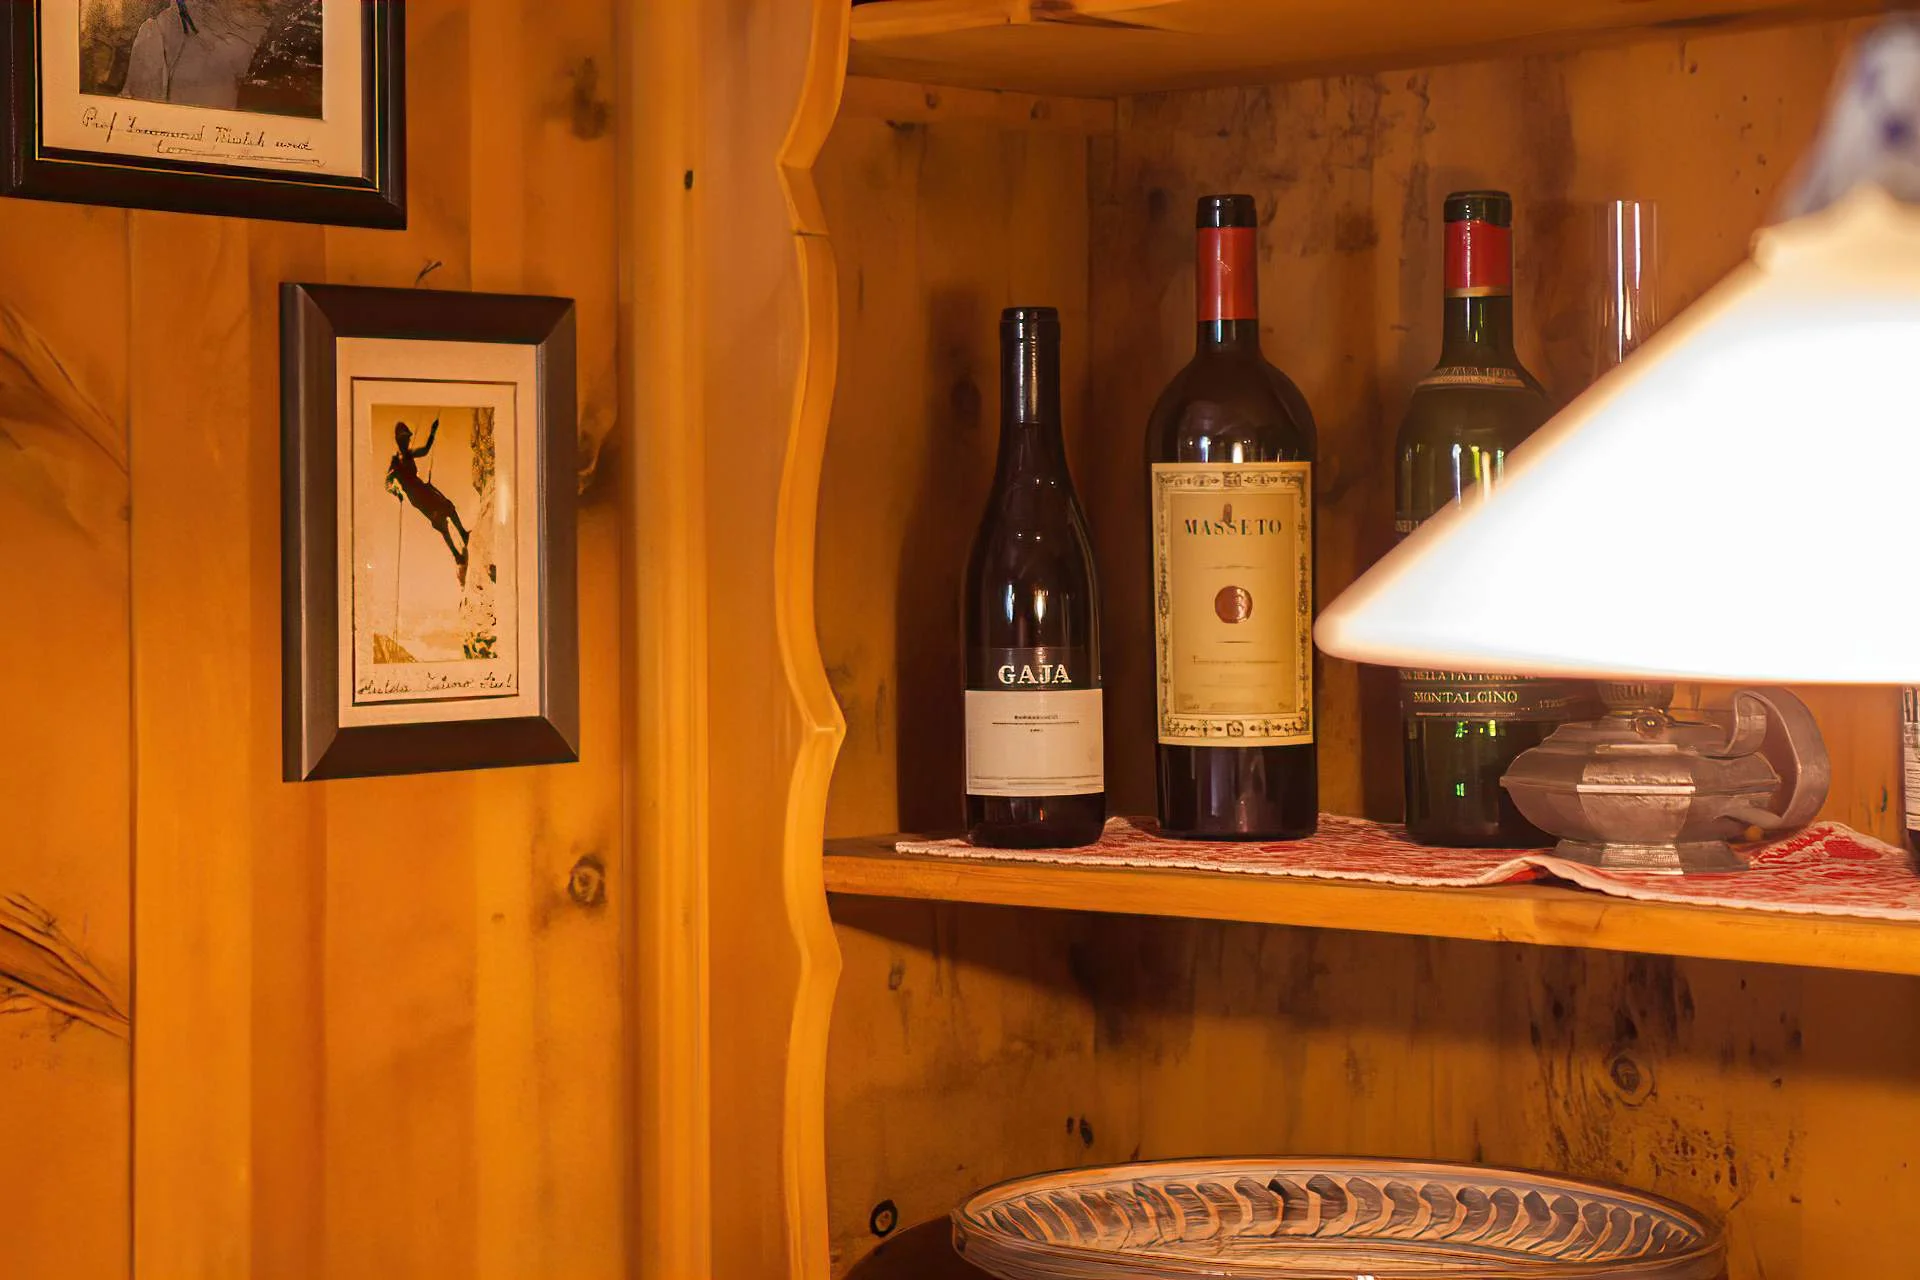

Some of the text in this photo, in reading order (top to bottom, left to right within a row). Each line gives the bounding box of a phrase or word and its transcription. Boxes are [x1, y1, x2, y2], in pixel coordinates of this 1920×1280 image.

[1184, 518, 1282, 537] MASSETO
[997, 663, 1072, 684] GAJA
[1413, 690, 1519, 704] MONTALCINO
